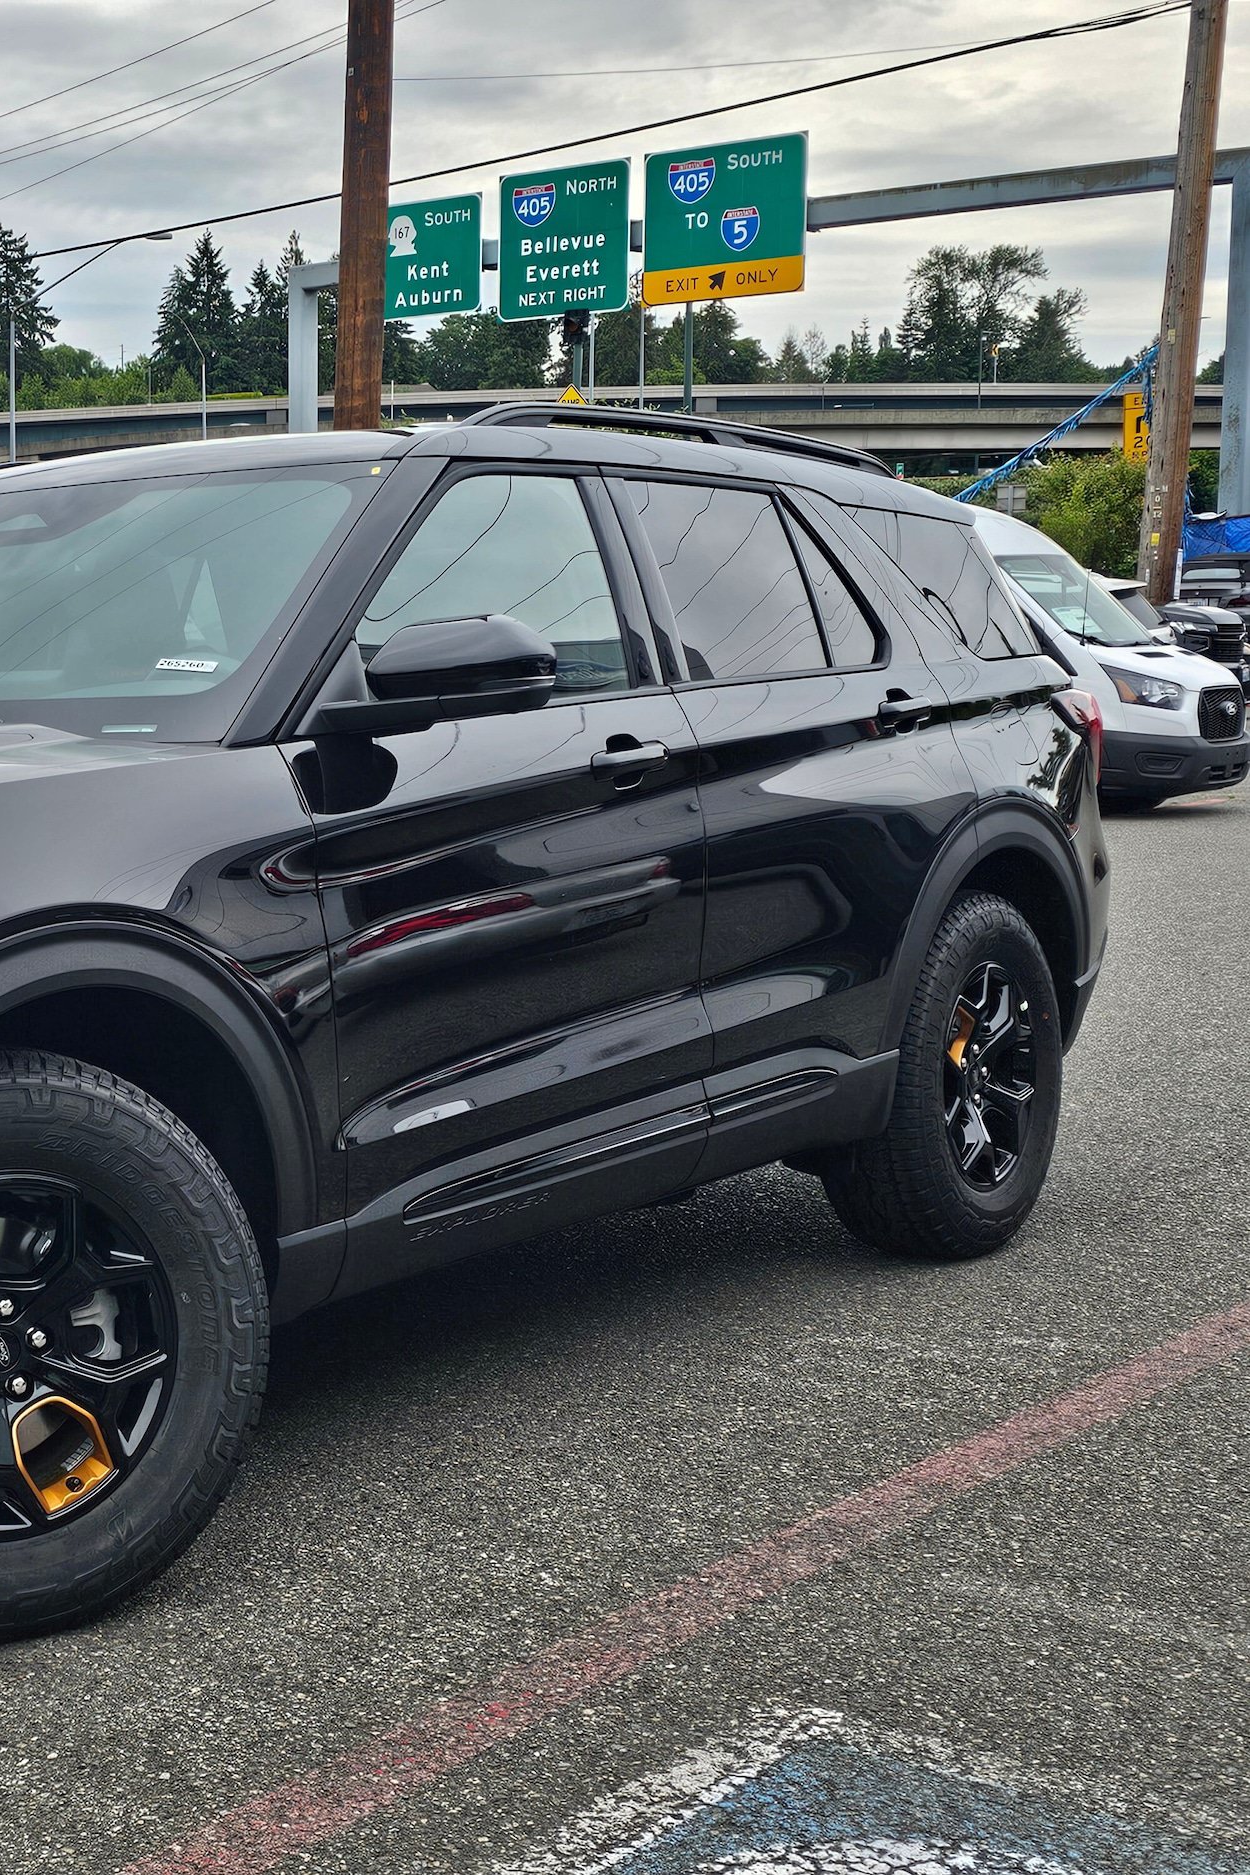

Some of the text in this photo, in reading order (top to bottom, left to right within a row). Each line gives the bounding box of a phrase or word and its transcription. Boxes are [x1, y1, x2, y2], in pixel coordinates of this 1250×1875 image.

[727, 149, 783, 170] SOUTH
[566, 176, 617, 196] NORTH
[673, 172, 710, 194] 405
[424, 209, 471, 226] SOUTH
[517, 197, 551, 218] 405
[685, 212, 709, 230] TO
[394, 226, 410, 240] 167
[733, 220, 748, 245] 5
[521, 233, 606, 256] Bellevue
[407, 260, 449, 281] Kent
[526, 259, 600, 283] Everett
[665, 268, 778, 293] EXIT ONLY
[394, 288, 463, 309] Auburn
[518, 285, 607, 307] NEXT RIGHT
[409, 1192, 551, 1242] EXPLORER
